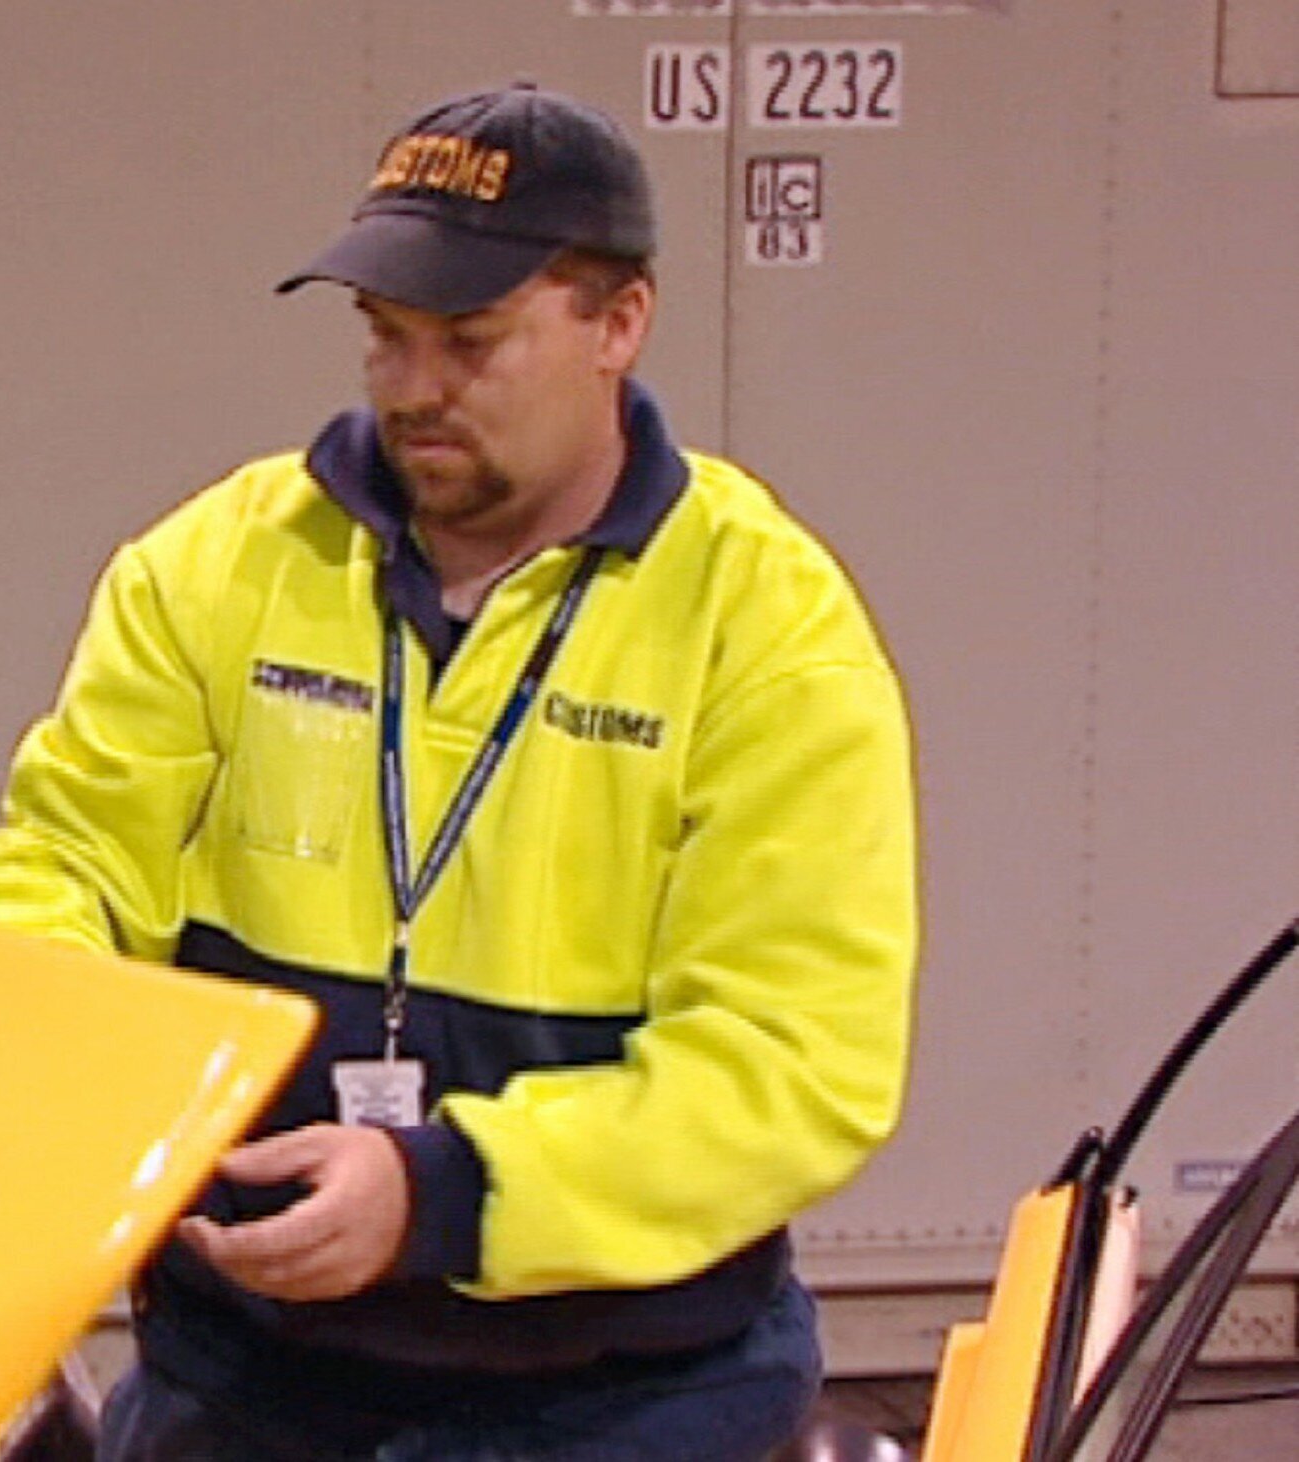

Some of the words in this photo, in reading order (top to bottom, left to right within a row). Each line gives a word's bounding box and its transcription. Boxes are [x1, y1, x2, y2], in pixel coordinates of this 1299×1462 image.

[650, 52, 720, 122] US
[764, 48, 896, 120] 2232
[544, 690, 665, 750] CUSTOMS
